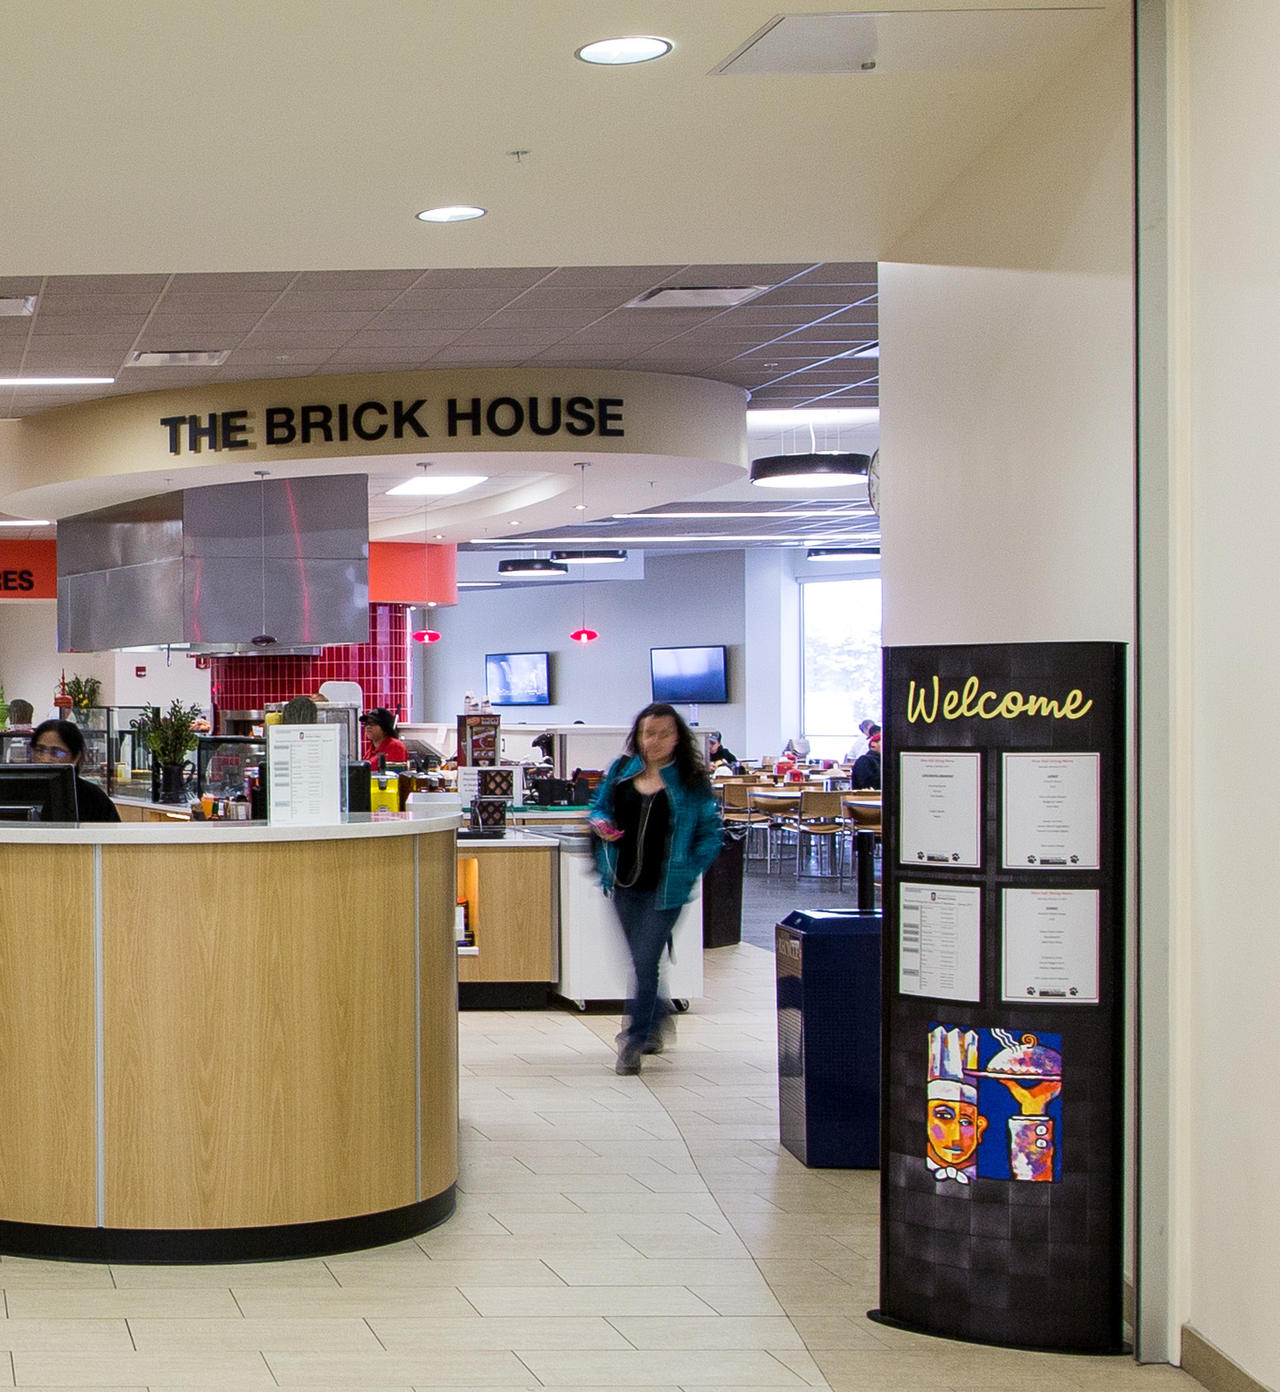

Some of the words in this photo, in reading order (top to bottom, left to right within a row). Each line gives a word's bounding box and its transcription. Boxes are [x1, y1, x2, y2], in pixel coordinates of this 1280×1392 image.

[160, 409, 250, 454] THE
[265, 399, 430, 446] BRICK
[447, 396, 626, 438] HOUSE
[907, 675, 1093, 724] Welcome
